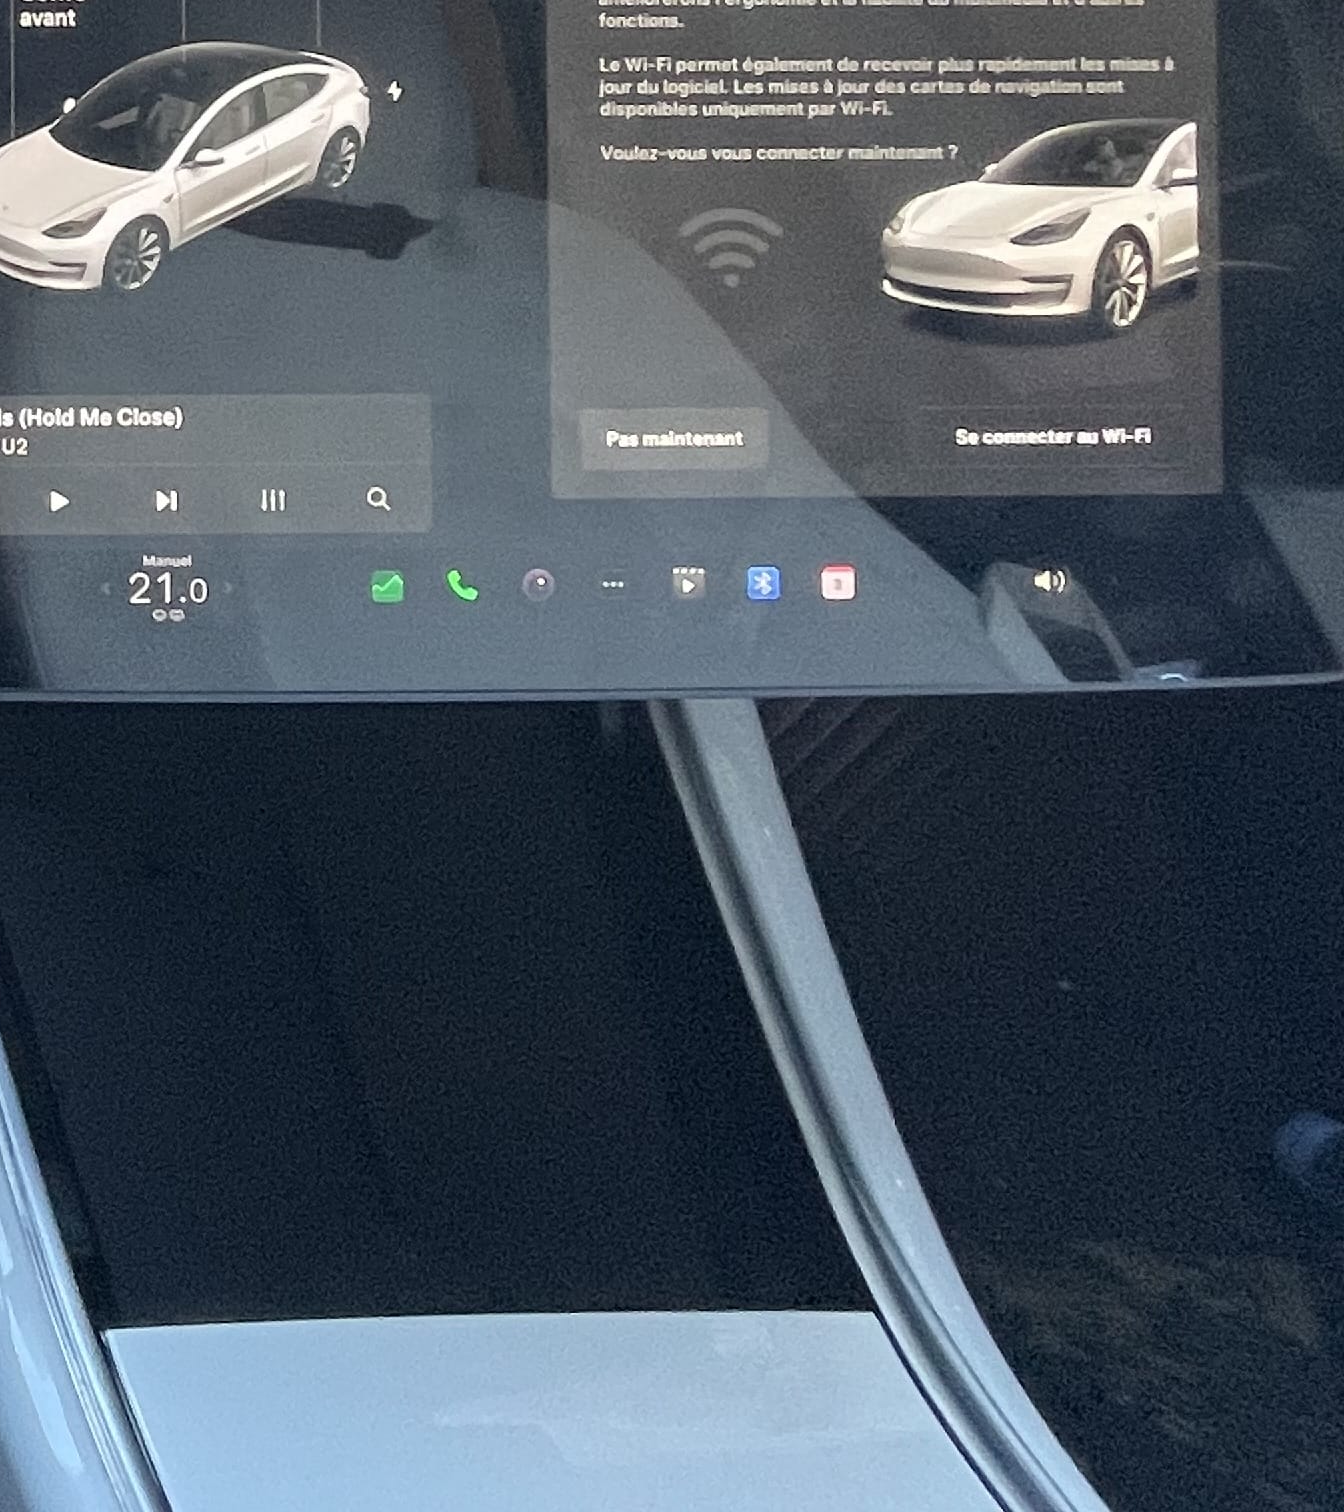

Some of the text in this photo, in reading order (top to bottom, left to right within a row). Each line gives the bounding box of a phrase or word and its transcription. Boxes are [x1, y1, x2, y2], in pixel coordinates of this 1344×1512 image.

[20, 9, 77, 28] avant
[598, 13, 685, 28] fonctions.
[598, 56, 1174, 75] Le Wi-Fi permet également de recevoir plus rapidement les mises à
[598, 79, 1125, 98] jour du logiciel. Les mises à jour des cartes de navigation sont
[600, 101, 893, 119] disponibles uniquement par Wi-Fi.
[601, 144, 959, 161] Voulez-vous vous connecter maintenant ?
[19, 407, 75, 429] (Hold
[80, 408, 112, 426] Me
[116, 406, 183, 429] Close)
[606, 430, 744, 448] Pas maintenant
[955, 428, 1152, 445] Se connecter au Wi-Fi
[1, 438, 29, 456] U2
[128, 571, 209, 605] 21.0
